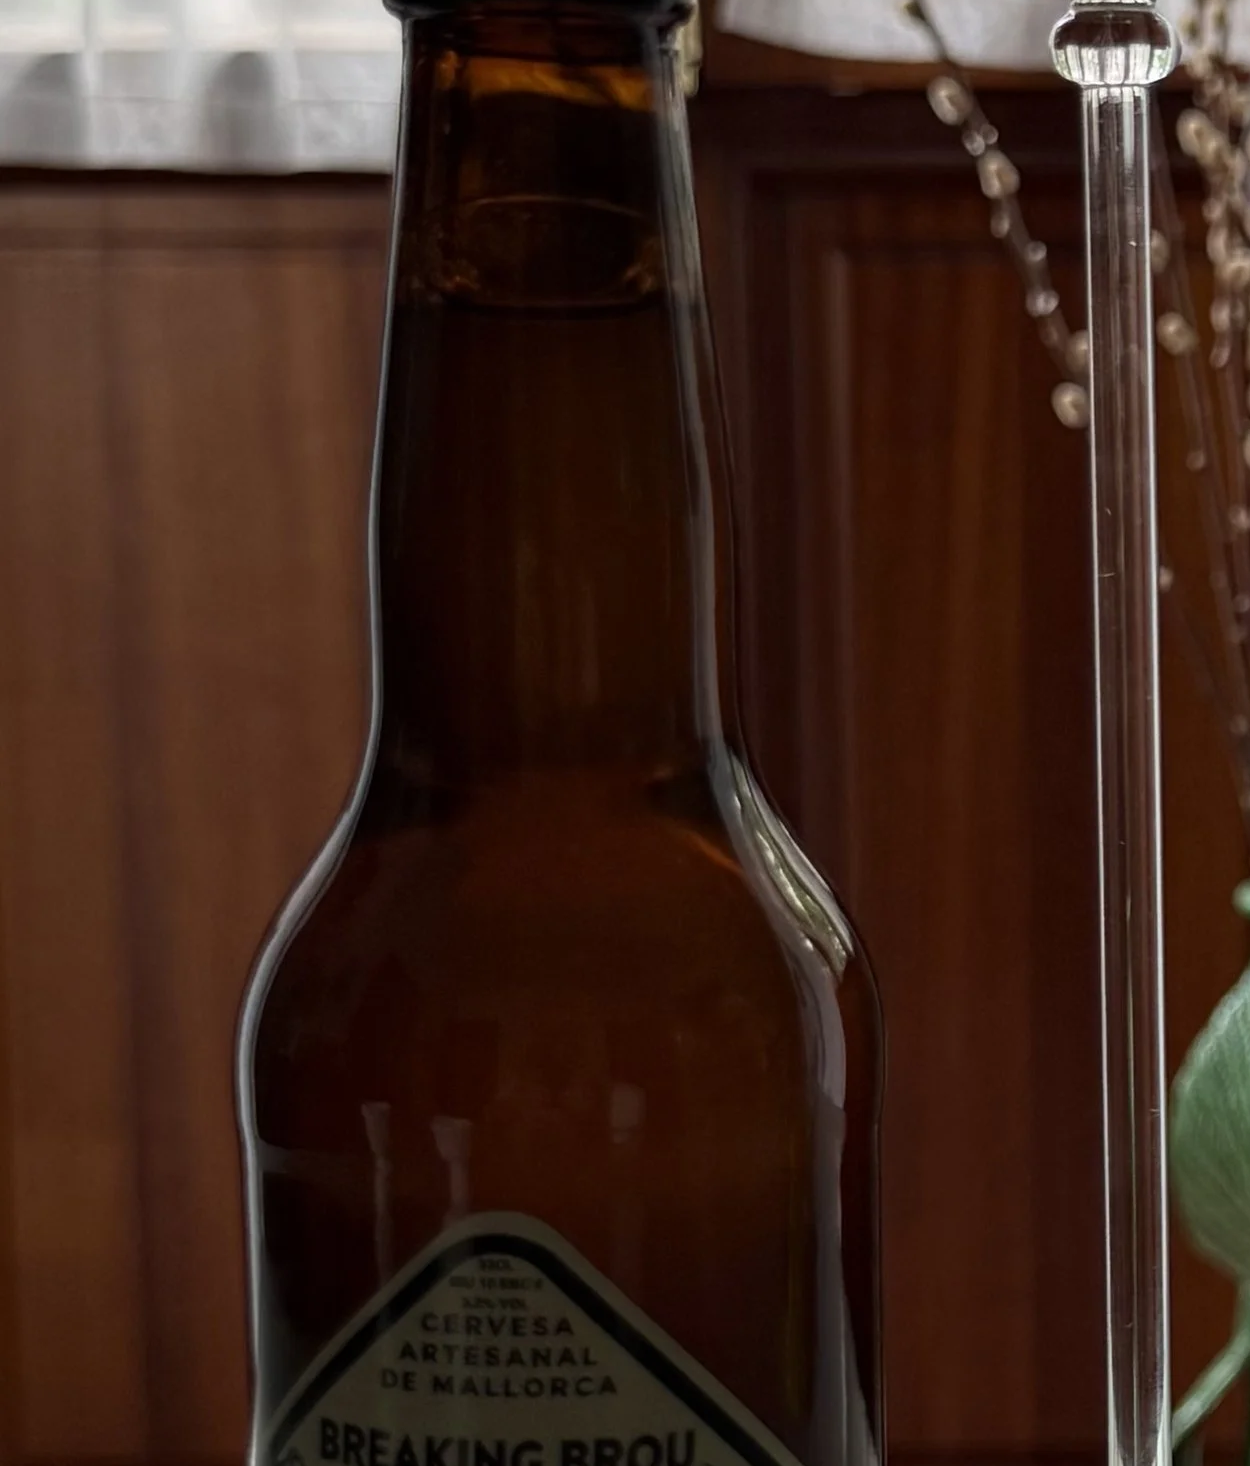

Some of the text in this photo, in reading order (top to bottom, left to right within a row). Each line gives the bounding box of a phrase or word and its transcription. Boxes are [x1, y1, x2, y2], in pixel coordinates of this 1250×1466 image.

[421, 1313, 574, 1337] CERVESA
[399, 1341, 598, 1367] ARTESANAL
[380, 1369, 617, 1398] DE MALLORCA
